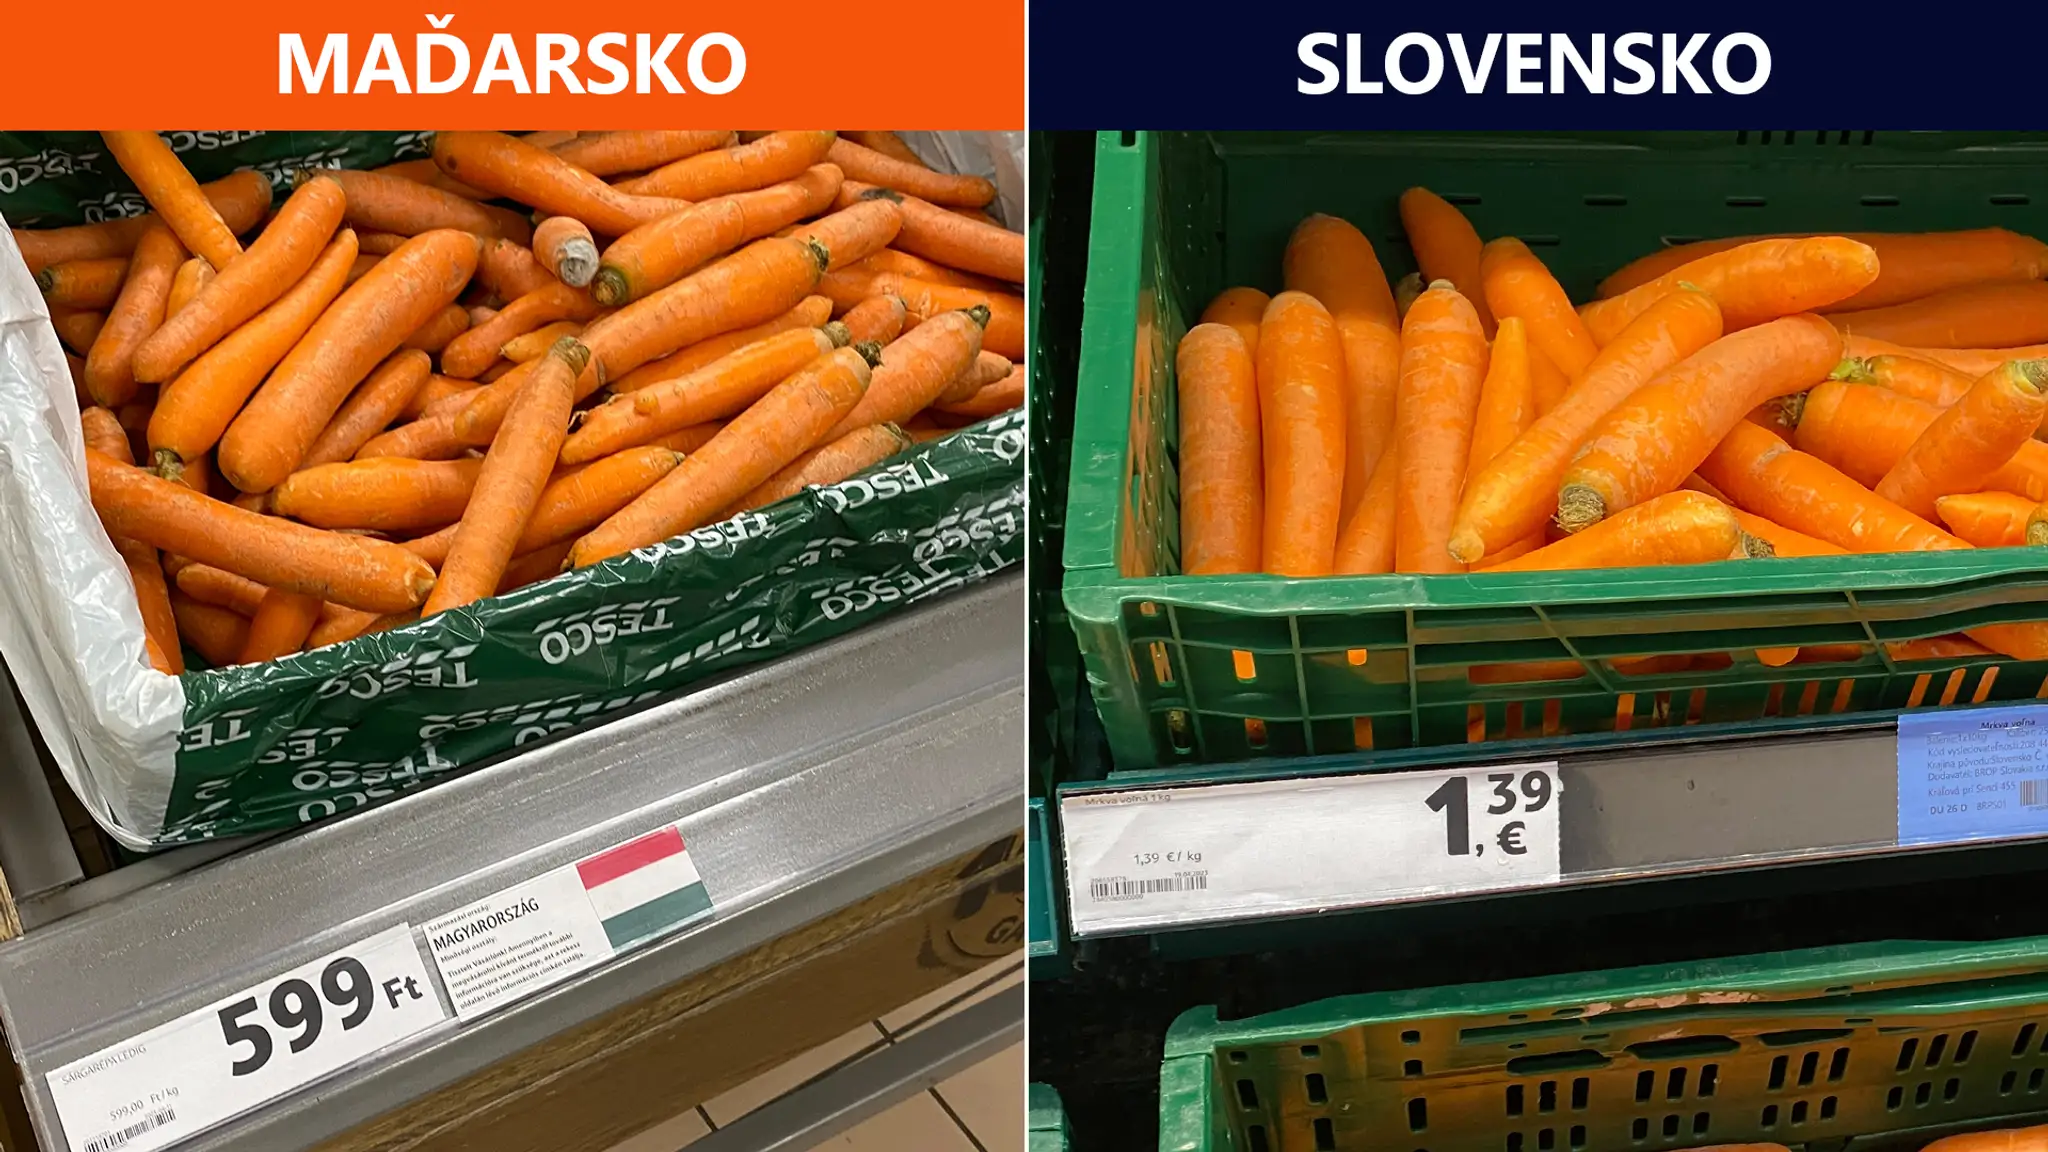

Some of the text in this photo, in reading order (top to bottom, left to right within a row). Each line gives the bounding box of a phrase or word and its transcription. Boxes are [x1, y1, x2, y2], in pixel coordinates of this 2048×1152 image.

[820, 560, 951, 620] TESCO
[540, 607, 674, 665] TESCO
[1084, 797, 1117, 806] Mrkva
[1158, 793, 1170, 802] kg
[1487, 770, 1552, 815] 39
[1930, 806, 1943, 814] DU
[1946, 804, 1957, 812] 26
[1496, 821, 1528, 856] €
[1133, 852, 1159, 866] 1,39
[433, 897, 540, 951] MAGYARORSZÁG
[216, 956, 424, 1077] 599 Ft
[117, 1045, 147, 1062] LEDIG
[108, 1098, 144, 1121] 599,00
